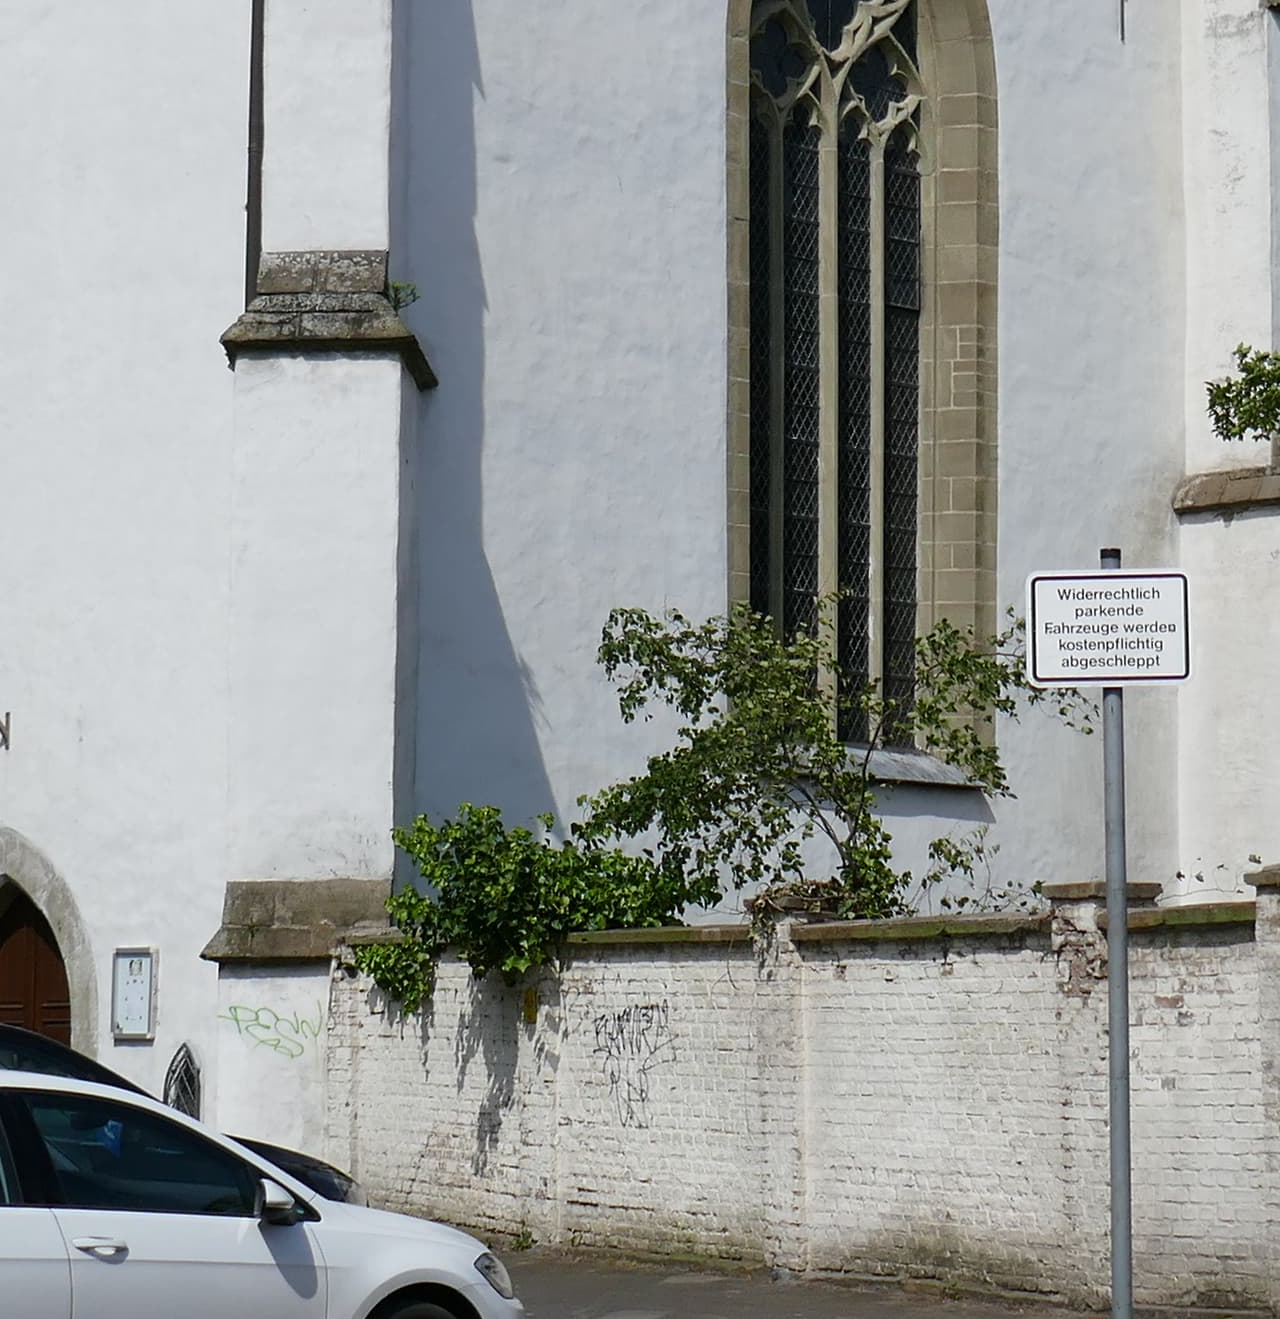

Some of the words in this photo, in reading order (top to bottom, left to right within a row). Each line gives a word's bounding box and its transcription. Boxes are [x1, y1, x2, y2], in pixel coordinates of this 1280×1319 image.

[1057, 587, 1160, 600] Widerrechtlich
[1075, 604, 1144, 619] parkende
[1044, 622, 1118, 636] Fahrzeuge
[1123, 621, 1176, 633] werden
[1059, 637, 1163, 653] kostenpflichtig
[1062, 655, 1160, 670] abgeschleppt
